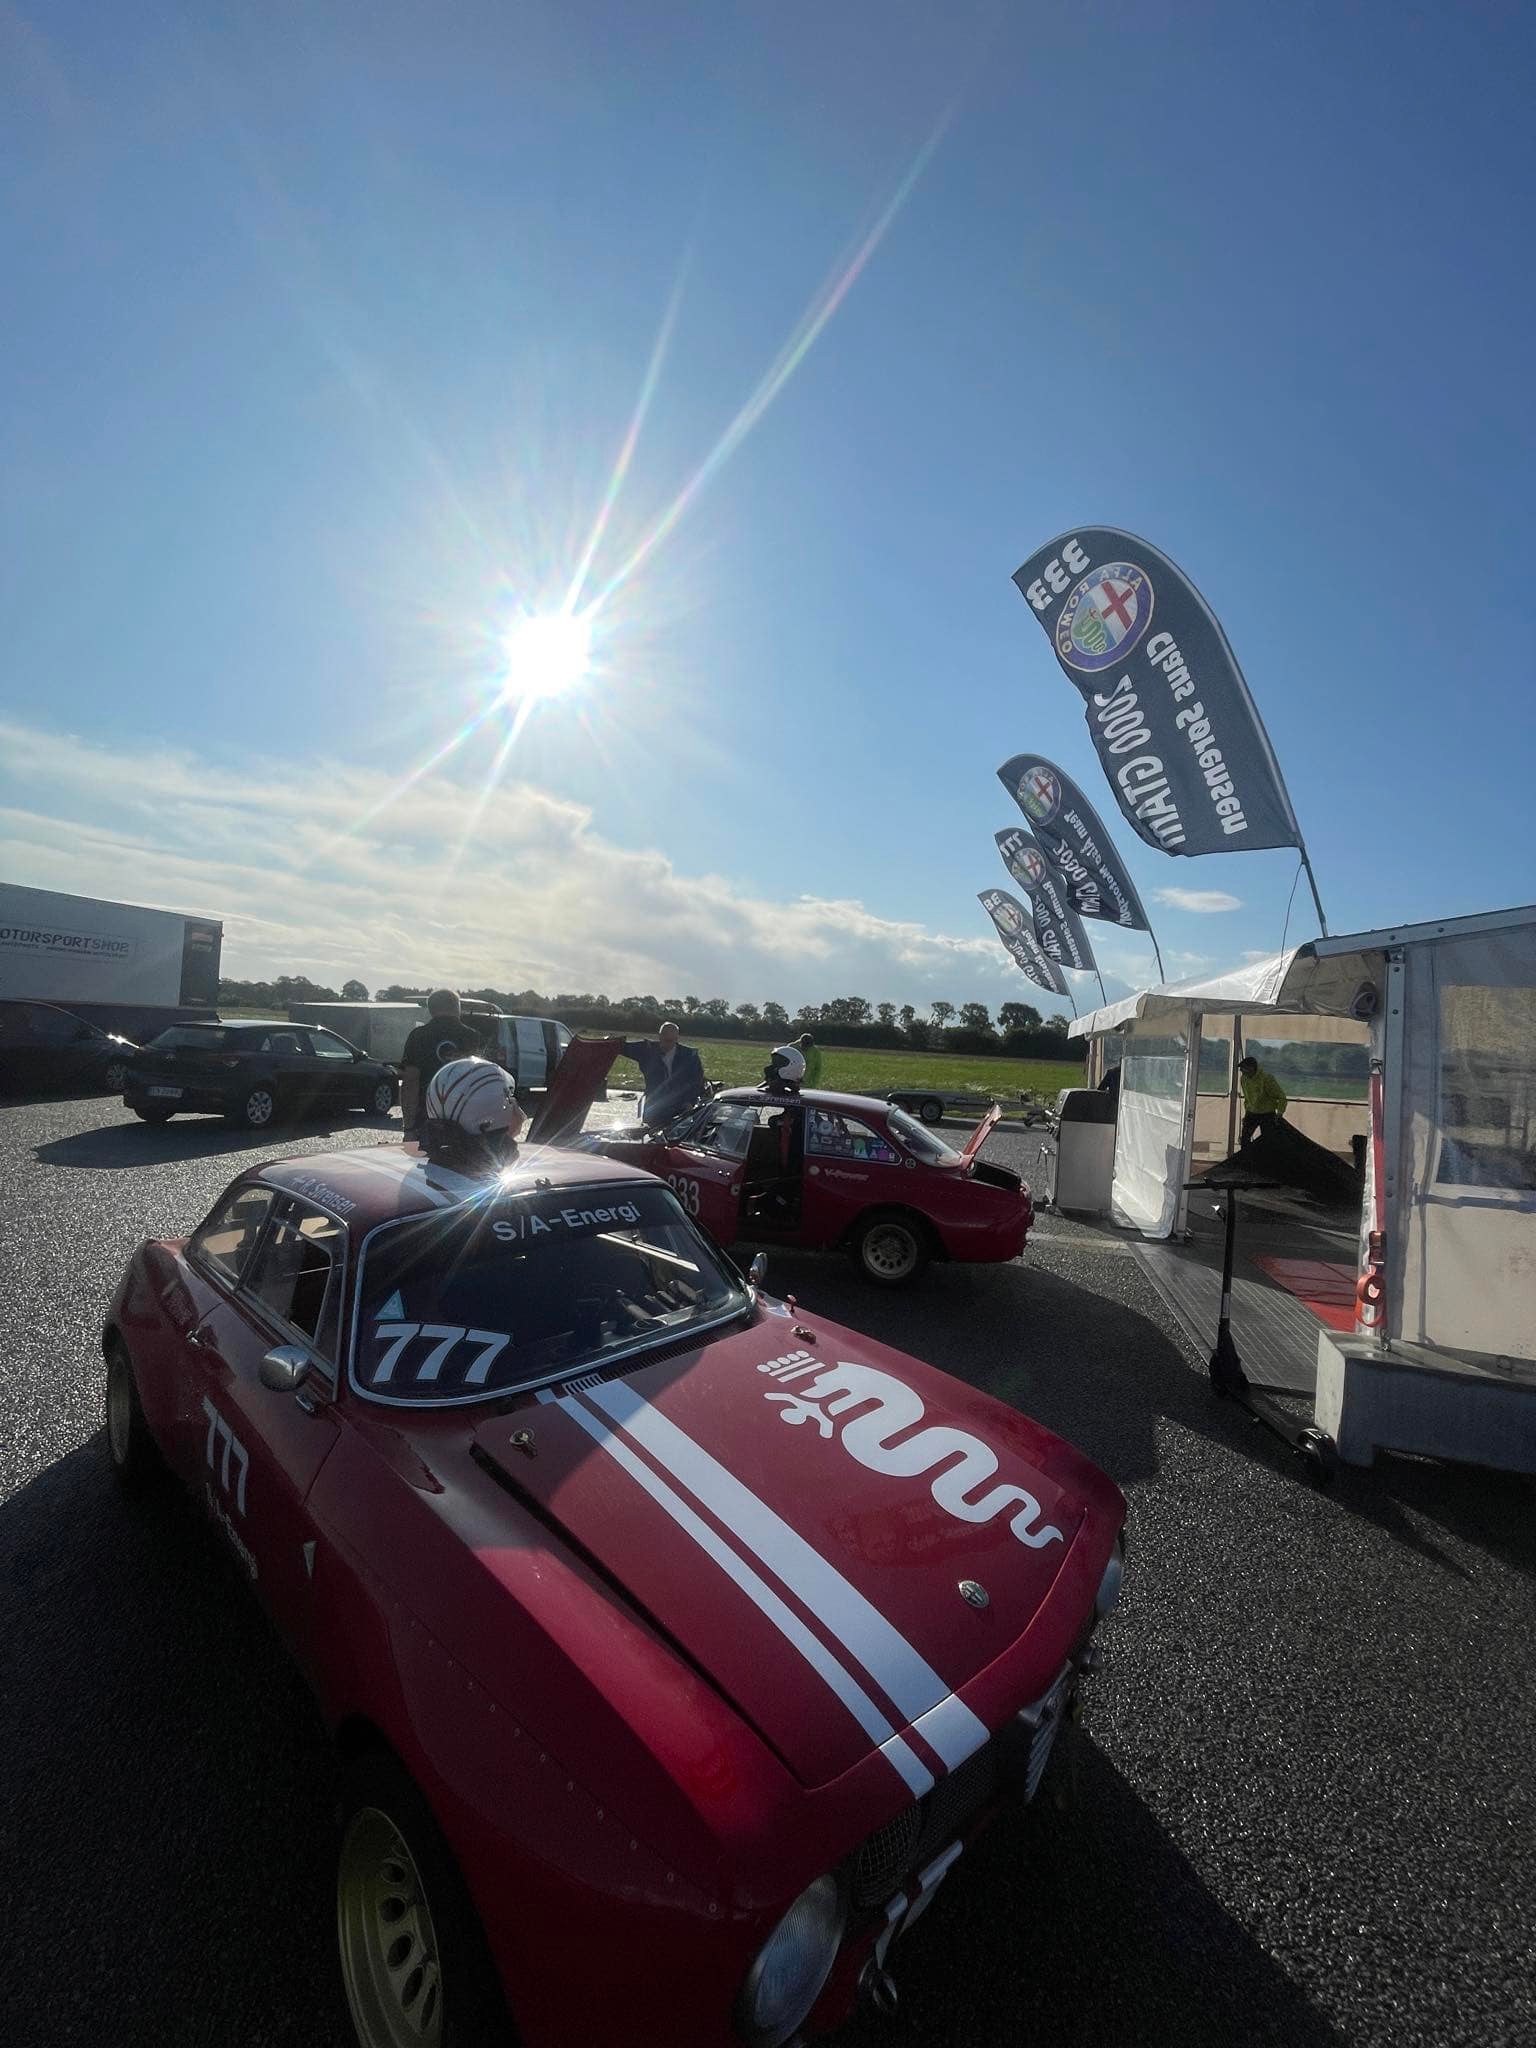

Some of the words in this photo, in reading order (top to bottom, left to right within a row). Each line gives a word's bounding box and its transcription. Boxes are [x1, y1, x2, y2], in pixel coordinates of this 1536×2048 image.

[0, 928, 129, 953] OTORSPORTSHOP
[492, 1201, 641, 1241] S/A-Energi
[372, 1323, 511, 1384] 777
[201, 1396, 249, 1518] 777
